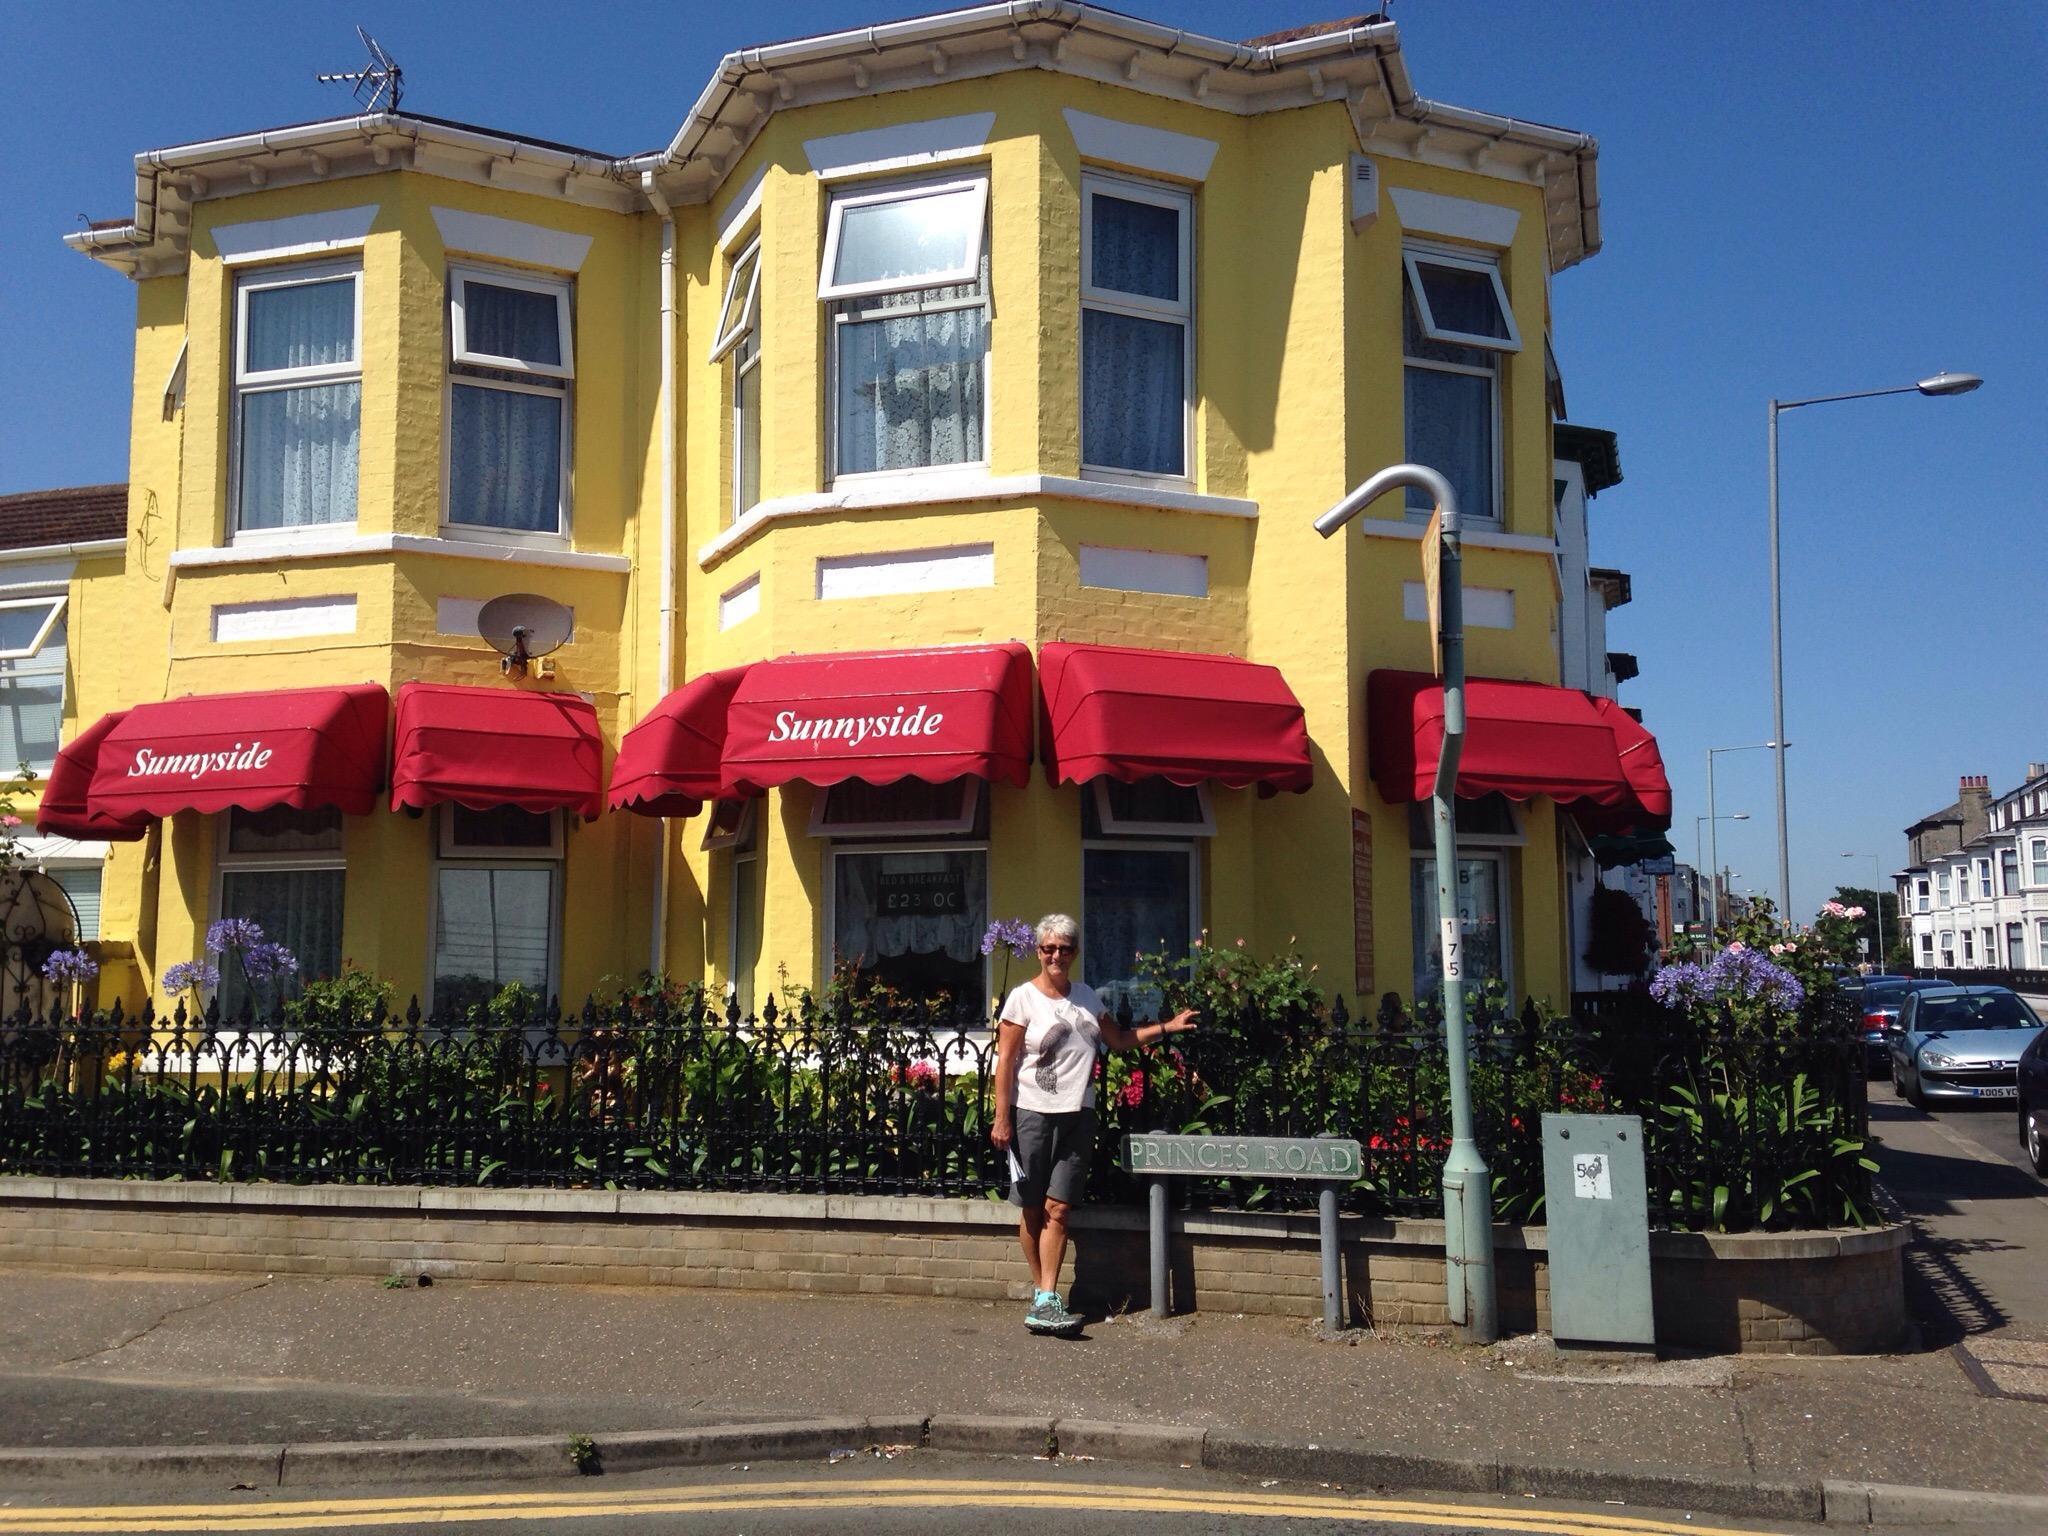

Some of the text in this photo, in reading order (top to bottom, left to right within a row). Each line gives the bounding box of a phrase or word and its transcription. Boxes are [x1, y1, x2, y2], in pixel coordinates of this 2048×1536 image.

[768, 705, 943, 747] Sunnyside
[127, 742, 273, 780] Sunnyside
[1130, 1141, 1352, 1173] PRINCES ROAD
